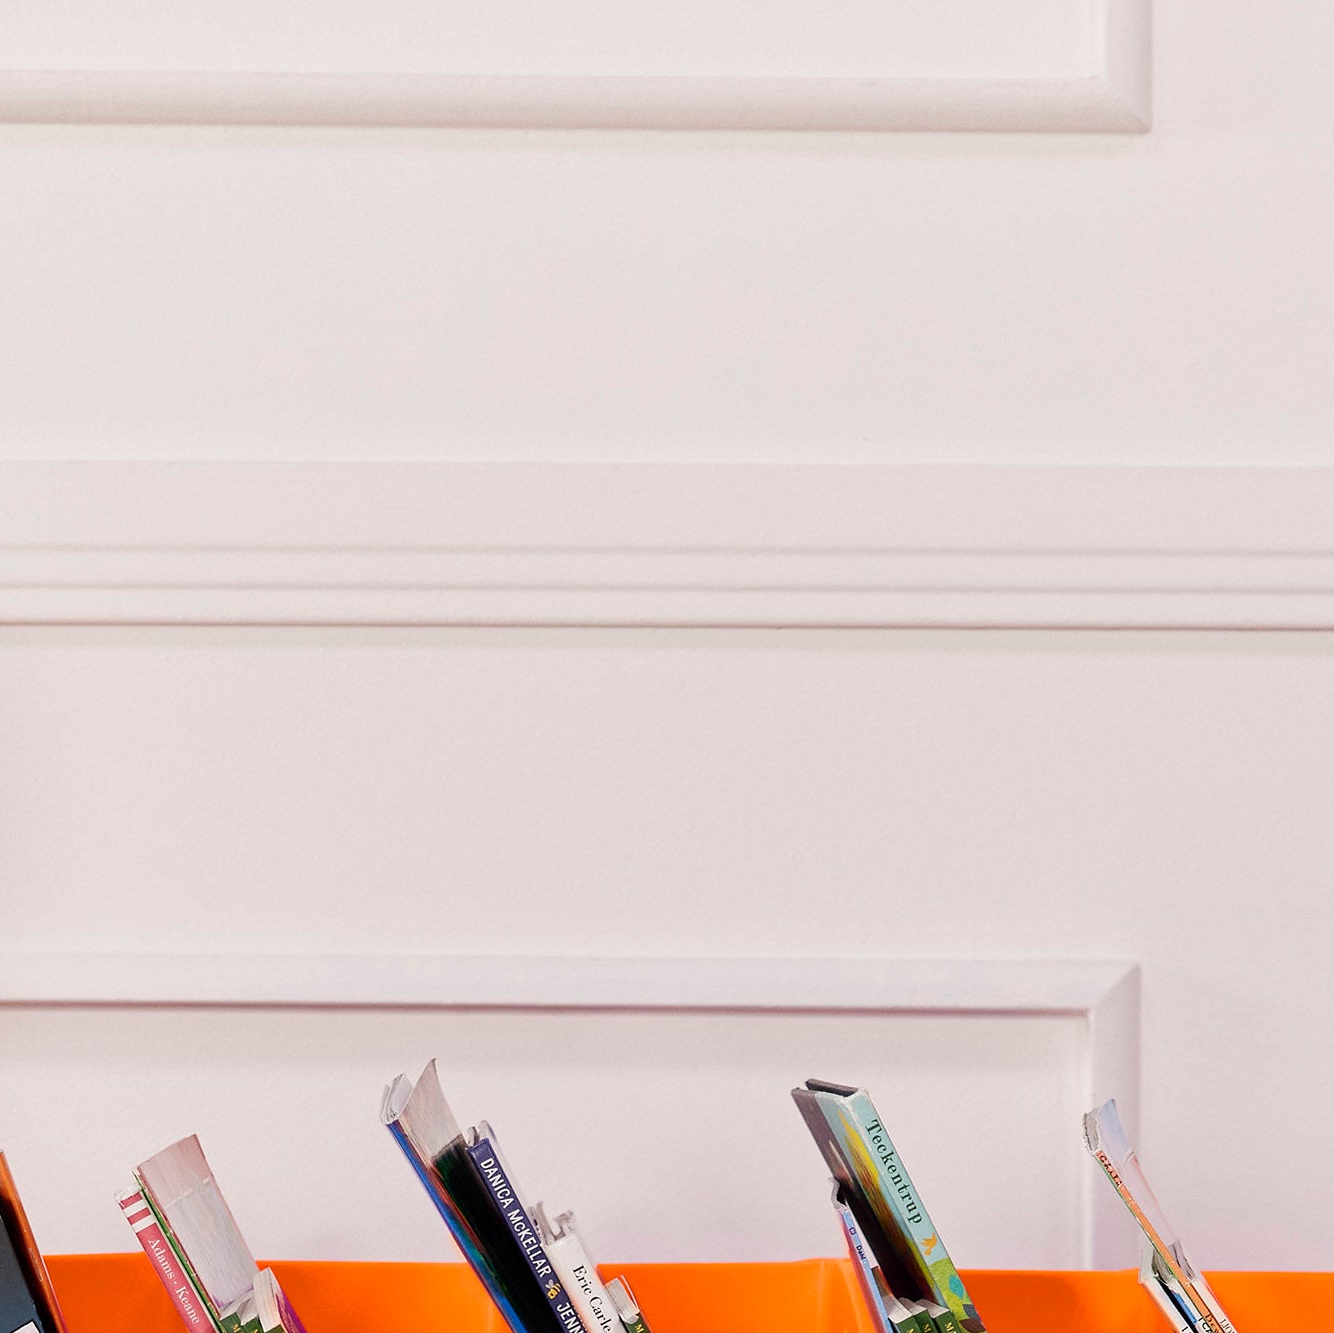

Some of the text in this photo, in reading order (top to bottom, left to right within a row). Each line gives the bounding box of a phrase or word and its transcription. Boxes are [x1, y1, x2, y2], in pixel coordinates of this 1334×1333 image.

[479, 1157, 552, 1278] DANICA McKELLAR
[866, 1118, 924, 1225] Teckentrup
[148, 1238, 201, 1325] Adams Keane
[572, 1264, 611, 1333] Eric Carle
